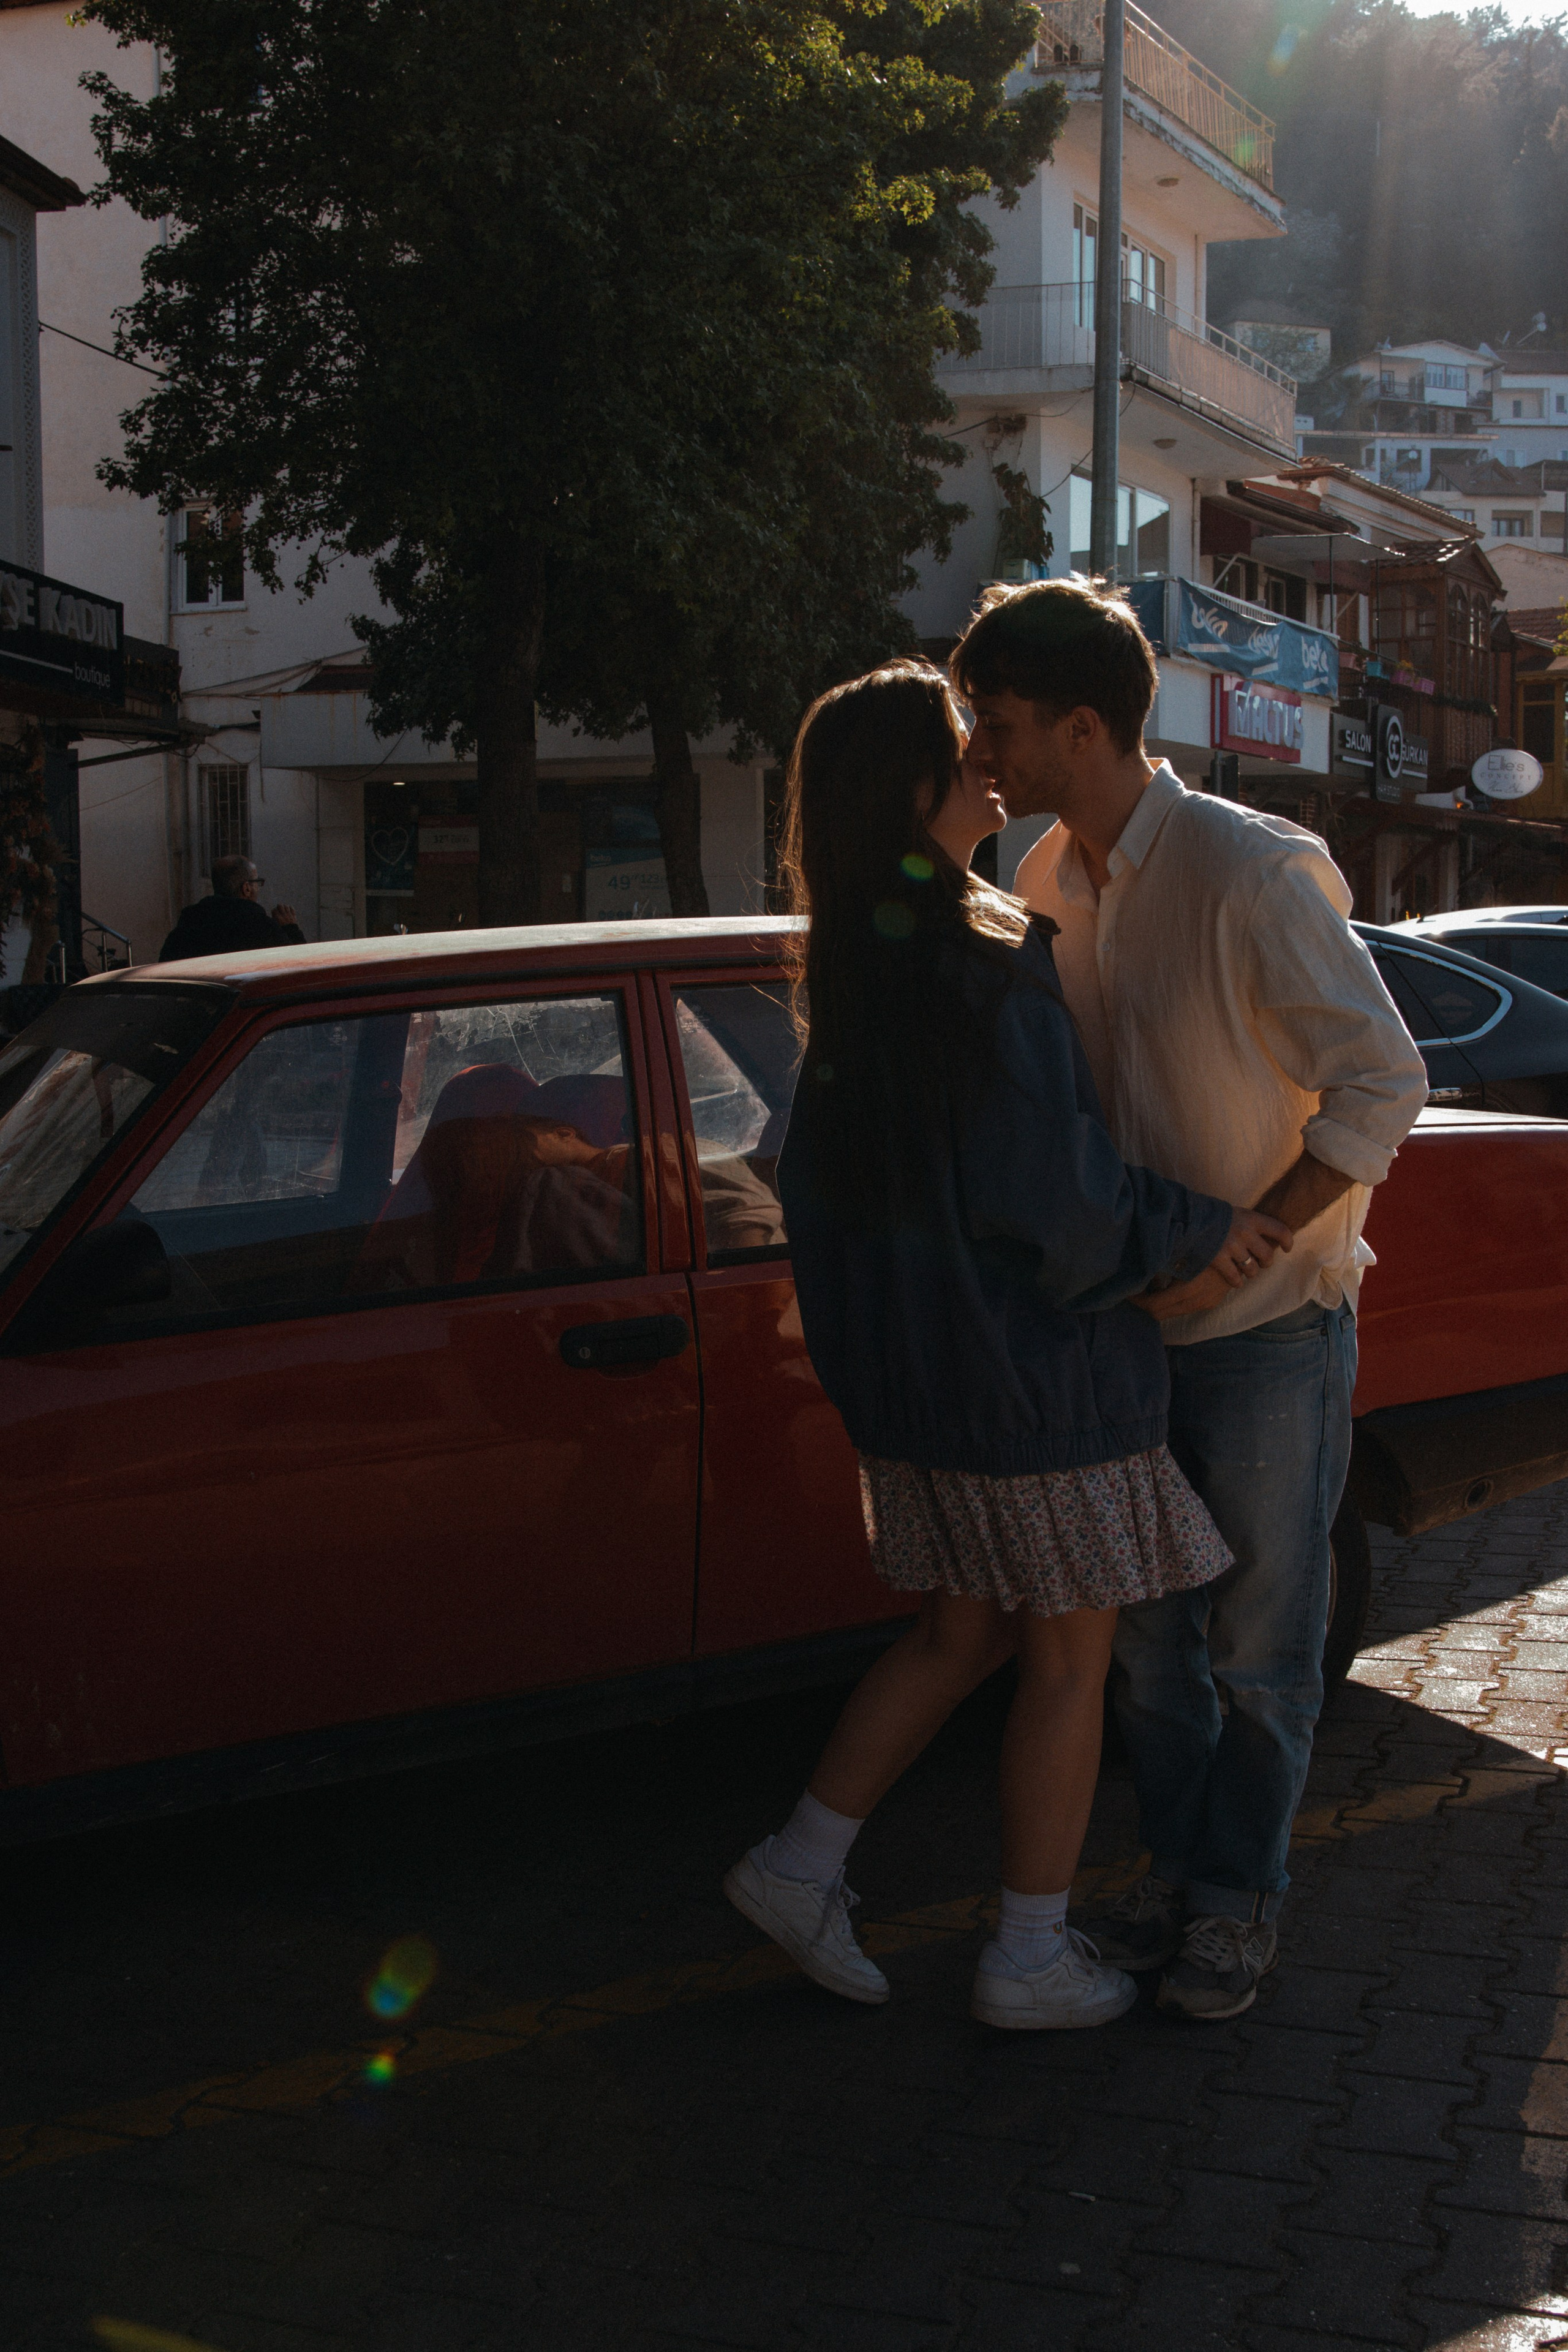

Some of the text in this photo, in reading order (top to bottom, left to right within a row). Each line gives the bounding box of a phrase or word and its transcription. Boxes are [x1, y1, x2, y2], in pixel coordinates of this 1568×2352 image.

[0, 570, 117, 650] ŞE KADIN
[75, 662, 111, 689] boutique
[1345, 729, 1371, 753] SALON
